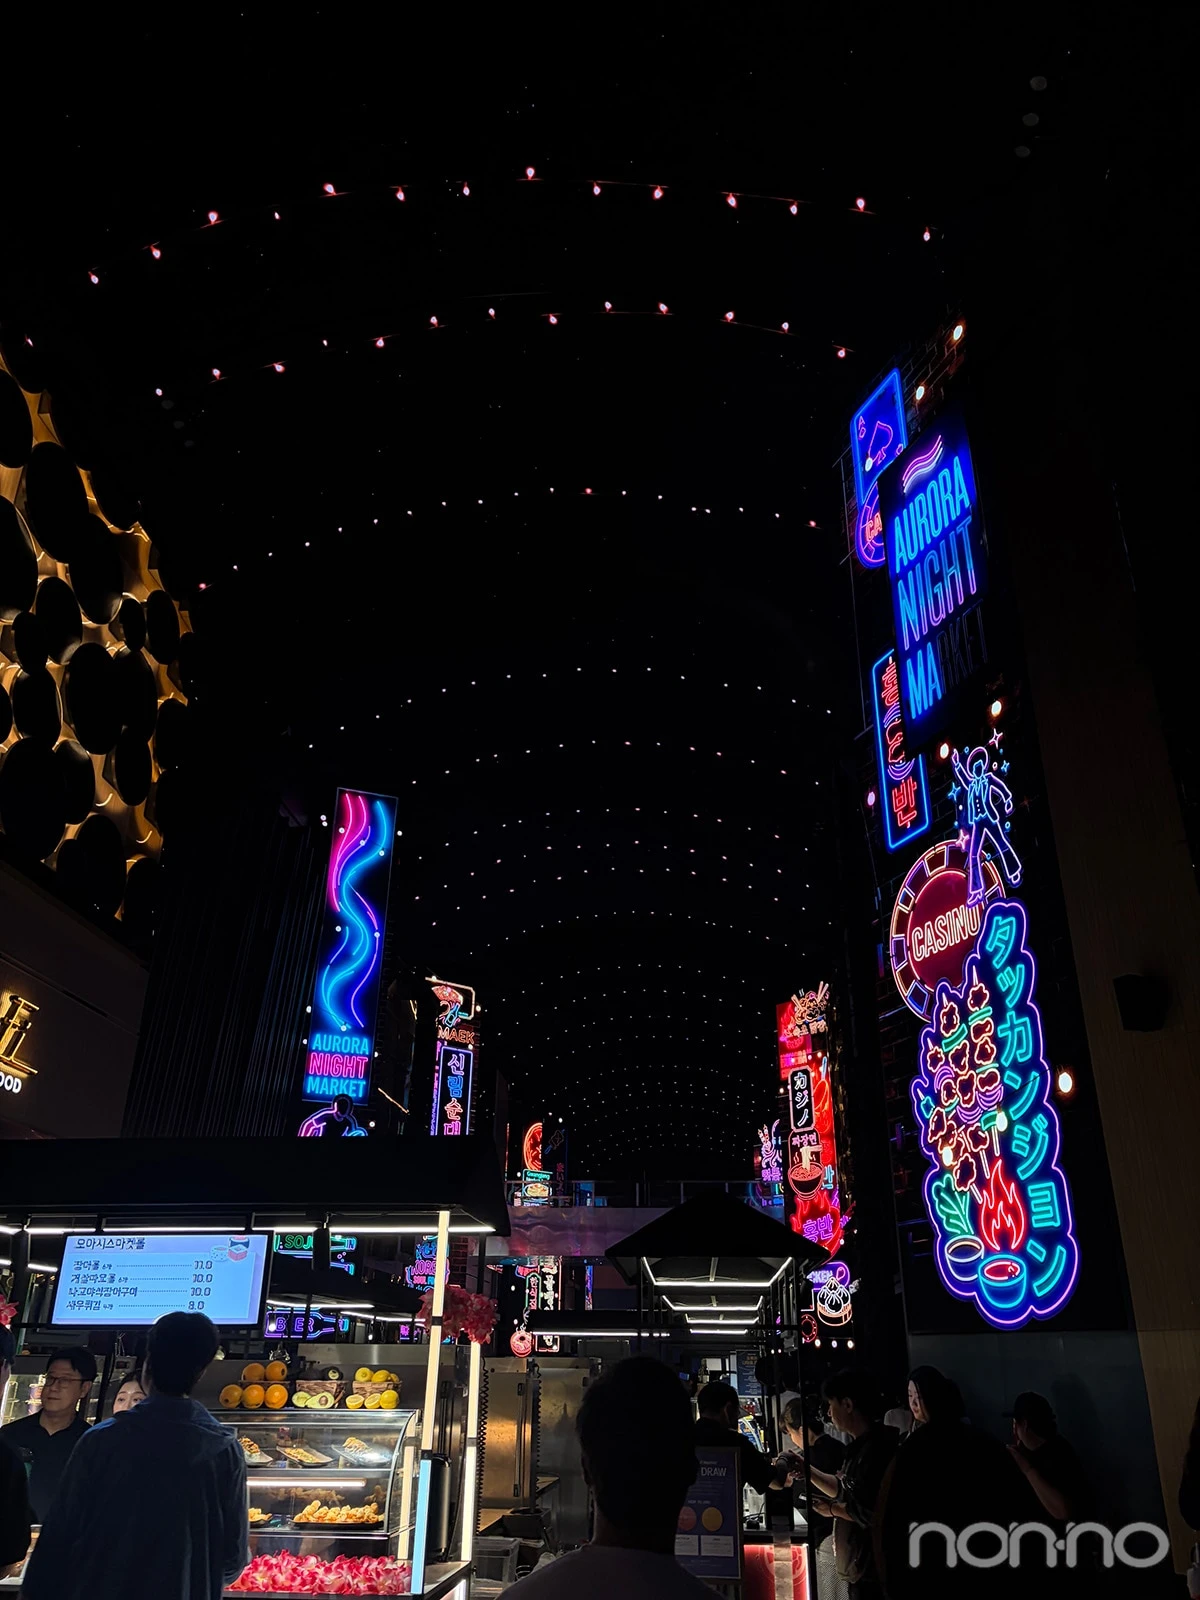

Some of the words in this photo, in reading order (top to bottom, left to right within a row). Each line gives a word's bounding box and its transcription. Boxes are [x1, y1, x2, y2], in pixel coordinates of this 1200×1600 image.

[894, 455, 970, 573] AURORA
[898, 515, 977, 651] NIGHT
[911, 904, 980, 961] CASINO
[312, 1033, 369, 1055] AURORA
[437, 1024, 475, 1044] MAEK
[309, 1052, 369, 1079] NIGHT
[307, 1075, 366, 1098] MARKET
[793, 1071, 809, 1127] カジノ
[985, 915, 1066, 1297] タッカンジョン
[284, 1235, 313, 1250] SOJ
[192, 1273, 213, 1283] 10.0
[190, 1286, 211, 1297] 10.0
[700, 1466, 728, 1478] DRAW
